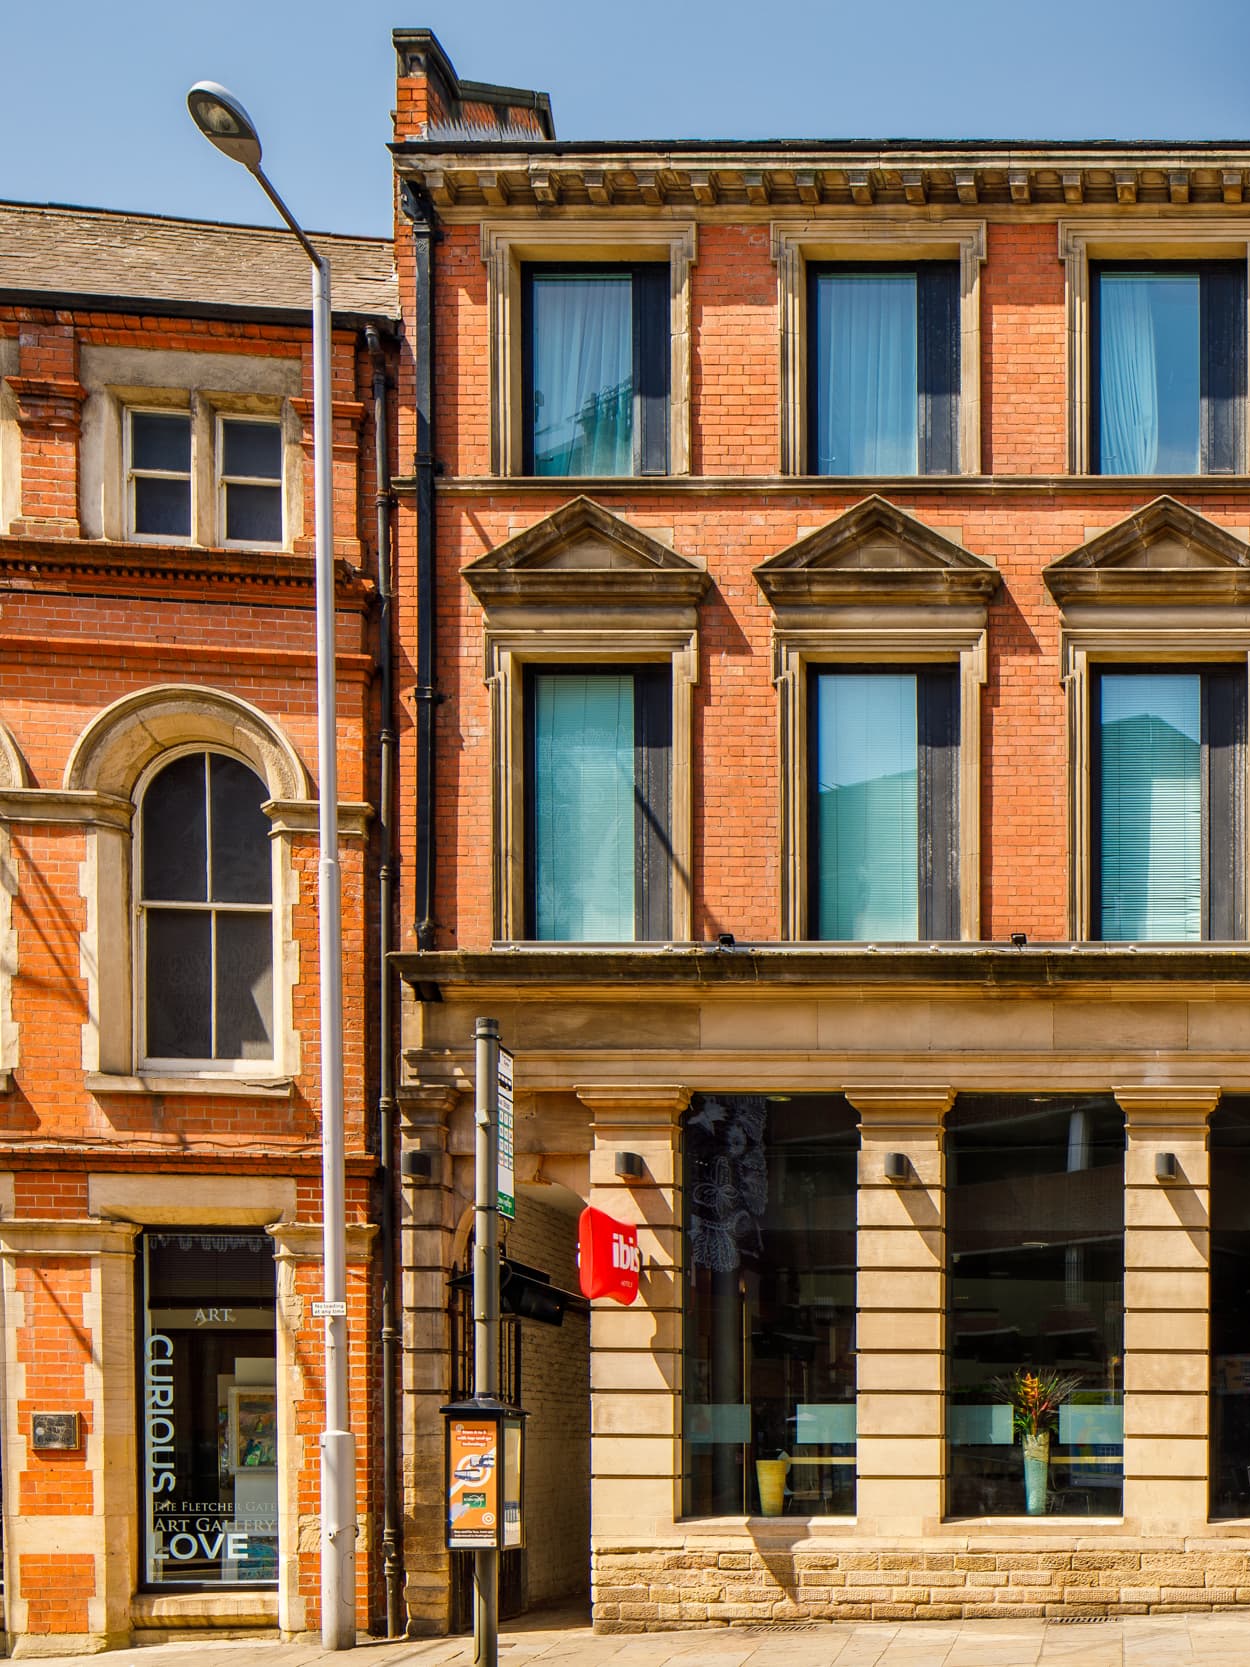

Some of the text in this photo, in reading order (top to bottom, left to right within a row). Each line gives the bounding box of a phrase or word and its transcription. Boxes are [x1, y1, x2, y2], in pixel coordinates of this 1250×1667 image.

[612, 1233, 639, 1272] ibis
[193, 1308, 233, 1322] ART
[145, 1334, 176, 1494] CURIOUS
[154, 1502, 276, 1512] THE FLETCHER GATE
[155, 1518, 275, 1532] ART GALLERY
[151, 1533, 249, 1560] LOVE
